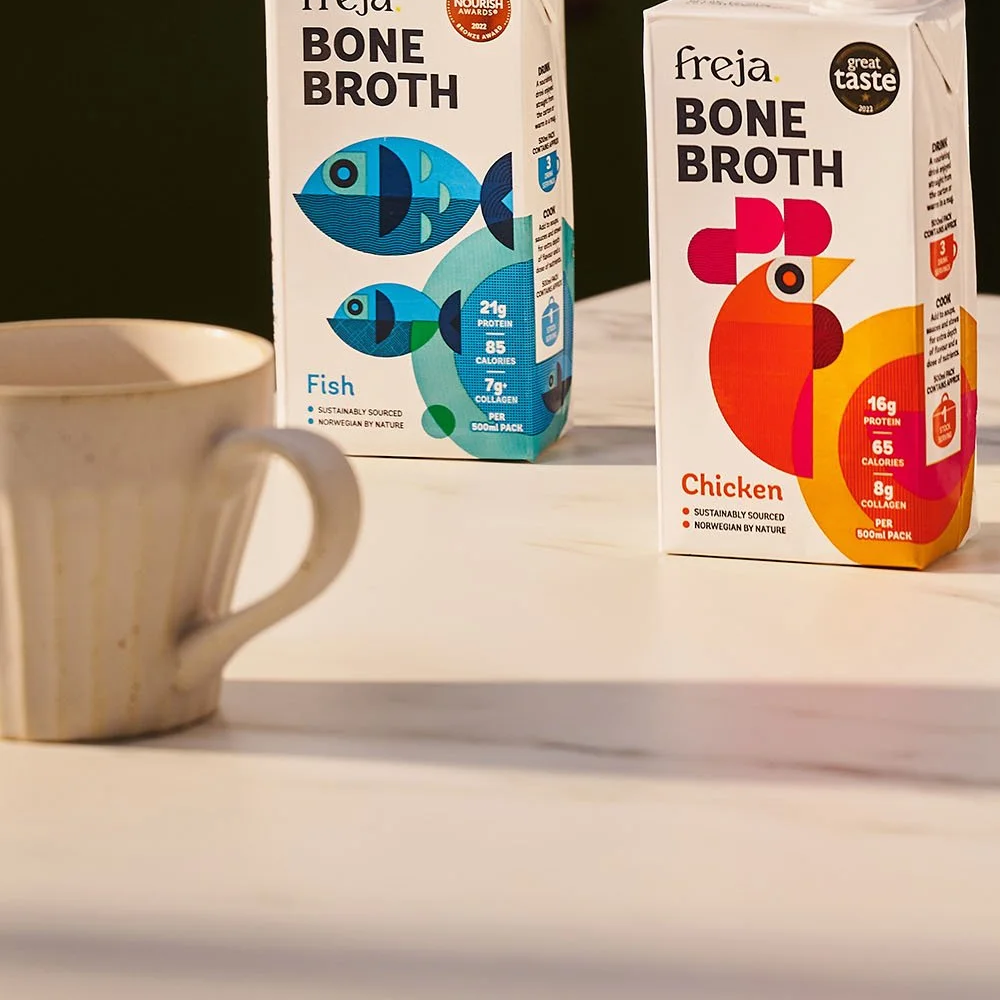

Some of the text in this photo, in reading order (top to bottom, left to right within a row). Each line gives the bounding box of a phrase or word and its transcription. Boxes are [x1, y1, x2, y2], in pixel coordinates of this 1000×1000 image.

[456, 24, 502, 39] BRONZE AWARD
[303, 27, 424, 64] BONE
[847, 57, 881, 72] great
[834, 69, 897, 91] taste
[304, 71, 458, 109] BROTH
[676, 97, 806, 138] BONE
[546, 155, 551, 171] 3
[677, 145, 843, 188] BROTH
[939, 239, 945, 256] 3
[936, 293, 950, 309] COOK
[480, 300, 506, 318] 21g
[478, 320, 512, 328] PROTEIN
[486, 340, 506, 354] 85
[476, 357, 516, 365] CALORIES
[308, 374, 354, 396] Fish
[476, 396, 518, 404] COLLAGEN
[868, 396, 896, 417] 16g
[318, 406, 402, 417] SUSTAINABLY SOURCED
[489, 412, 505, 422] PER
[942, 406, 946, 424] 1
[318, 419, 404, 429] NORWEGIAN BY NATURE
[472, 423, 523, 432] 500ml PACK
[864, 417, 901, 426] PROTEIN
[872, 440, 893, 455] 65
[862, 458, 904, 467] CALORIES
[682, 473, 783, 500] Chicken
[873, 481, 893, 500] 8g
[861, 500, 906, 509] COLLAGEN
[694, 508, 784, 521] SUSTAINABLY SOURCED
[694, 521, 786, 534] NORWEGIAN BY NATURE
[876, 518, 893, 528] PER
[857, 529, 912, 540] 500ml PACK
